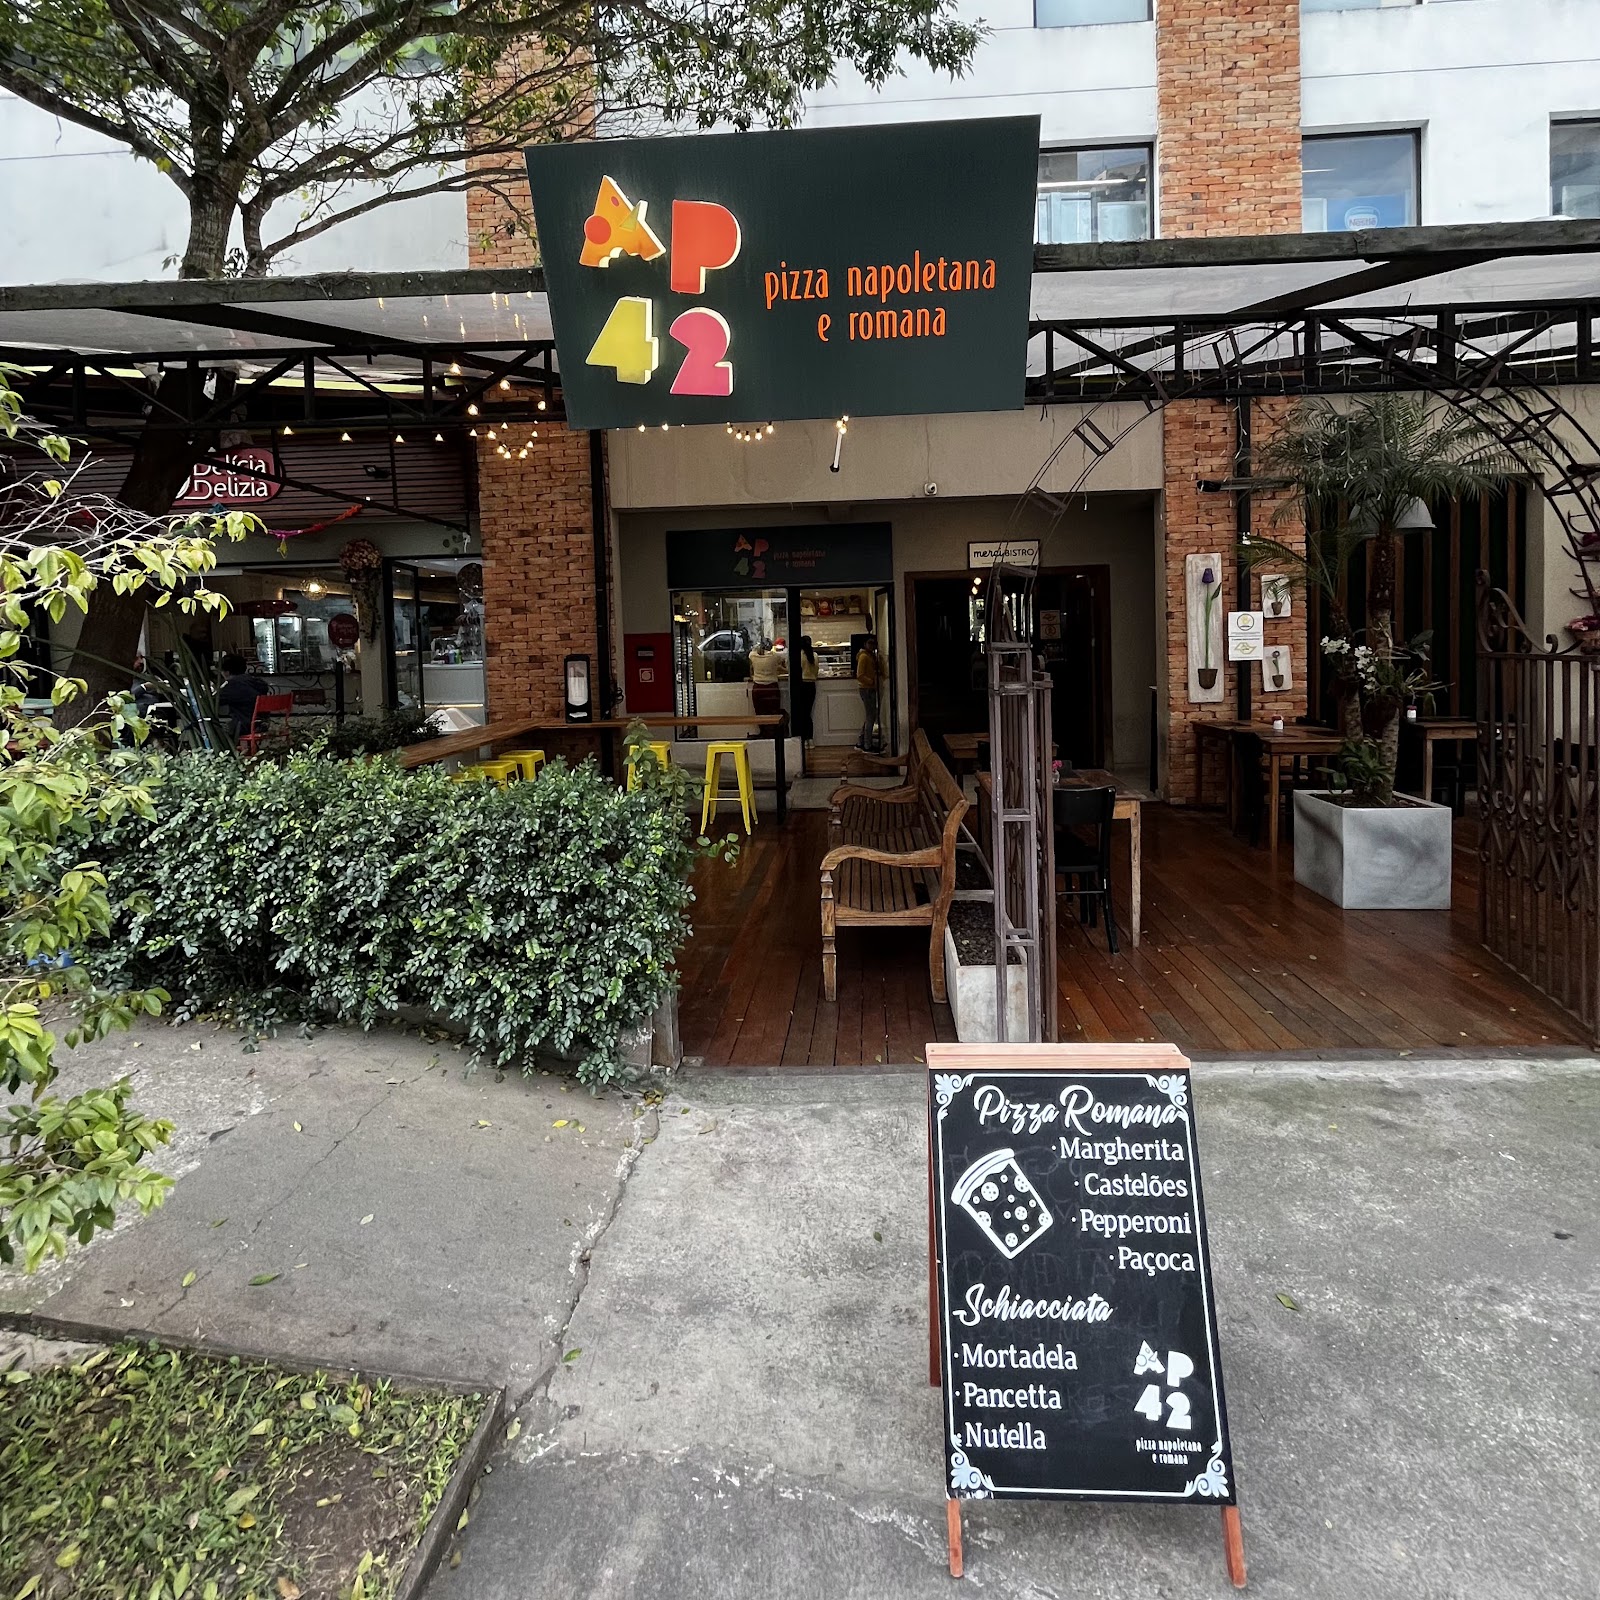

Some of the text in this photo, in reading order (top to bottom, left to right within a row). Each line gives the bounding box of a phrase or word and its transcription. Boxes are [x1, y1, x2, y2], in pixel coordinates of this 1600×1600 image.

[579, 174, 742, 294] AP
[764, 249, 996, 310] pizza napoletana
[817, 307, 946, 342] e romana
[585, 295, 734, 397] 42
[183, 477, 268, 500] Delizia
[734, 533, 770, 557] AP
[733, 557, 767, 579] 42
[973, 1084, 1181, 1137] Pizza Romana
[1059, 1136, 1184, 1166] Margherita
[1084, 1172, 1188, 1197] Castelões
[1080, 1209, 1192, 1239] Pepperoni
[1118, 1246, 1195, 1277] Paçoca
[953, 1283, 1114, 1327] Schiacciata
[961, 1342, 1078, 1371] Mortadela
[1133, 1339, 1194, 1387] AP
[964, 1383, 1062, 1410] Pancetta
[1134, 1384, 1192, 1430] 42
[964, 1421, 1047, 1450] Nutella
[1135, 1437, 1202, 1453] pizza napoletana
[1152, 1453, 1188, 1464] e romana
